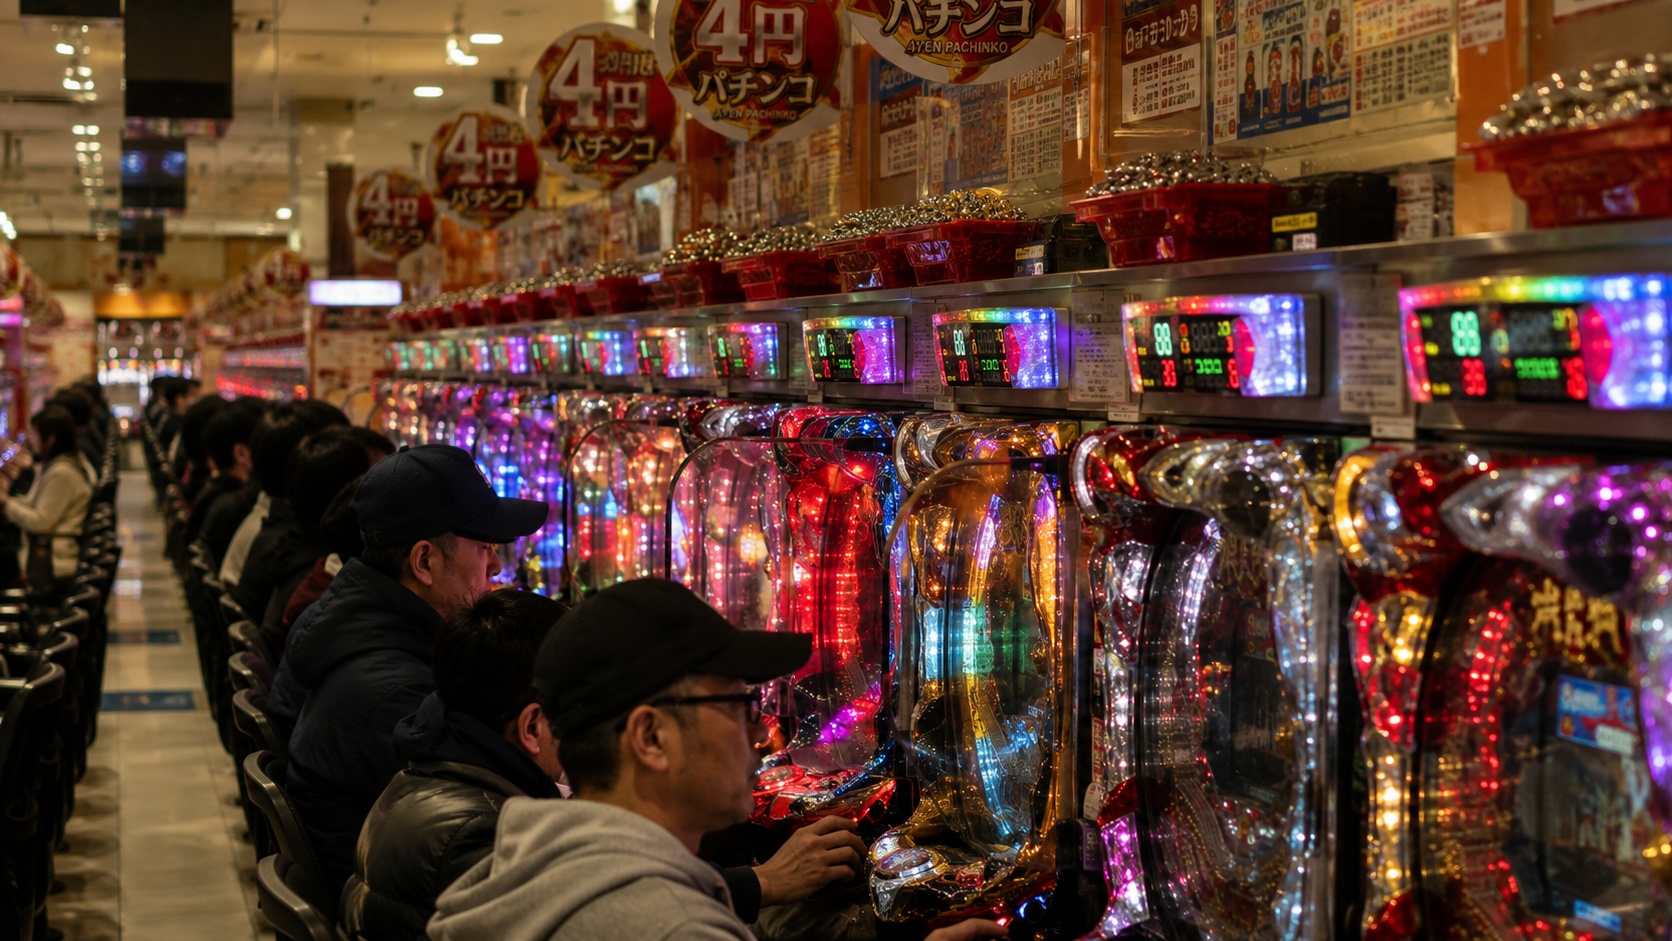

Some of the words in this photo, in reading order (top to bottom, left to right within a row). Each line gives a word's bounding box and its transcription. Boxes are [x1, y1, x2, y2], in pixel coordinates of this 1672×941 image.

[696, 0, 805, 66] 4円
[946, 41, 1008, 54] PACHINKO
[548, 37, 648, 129] 4円
[693, 69, 815, 105] パチンコ
[443, 115, 518, 184] 4円
[558, 131, 656, 161] パチンコ
[361, 174, 419, 227] 4円
